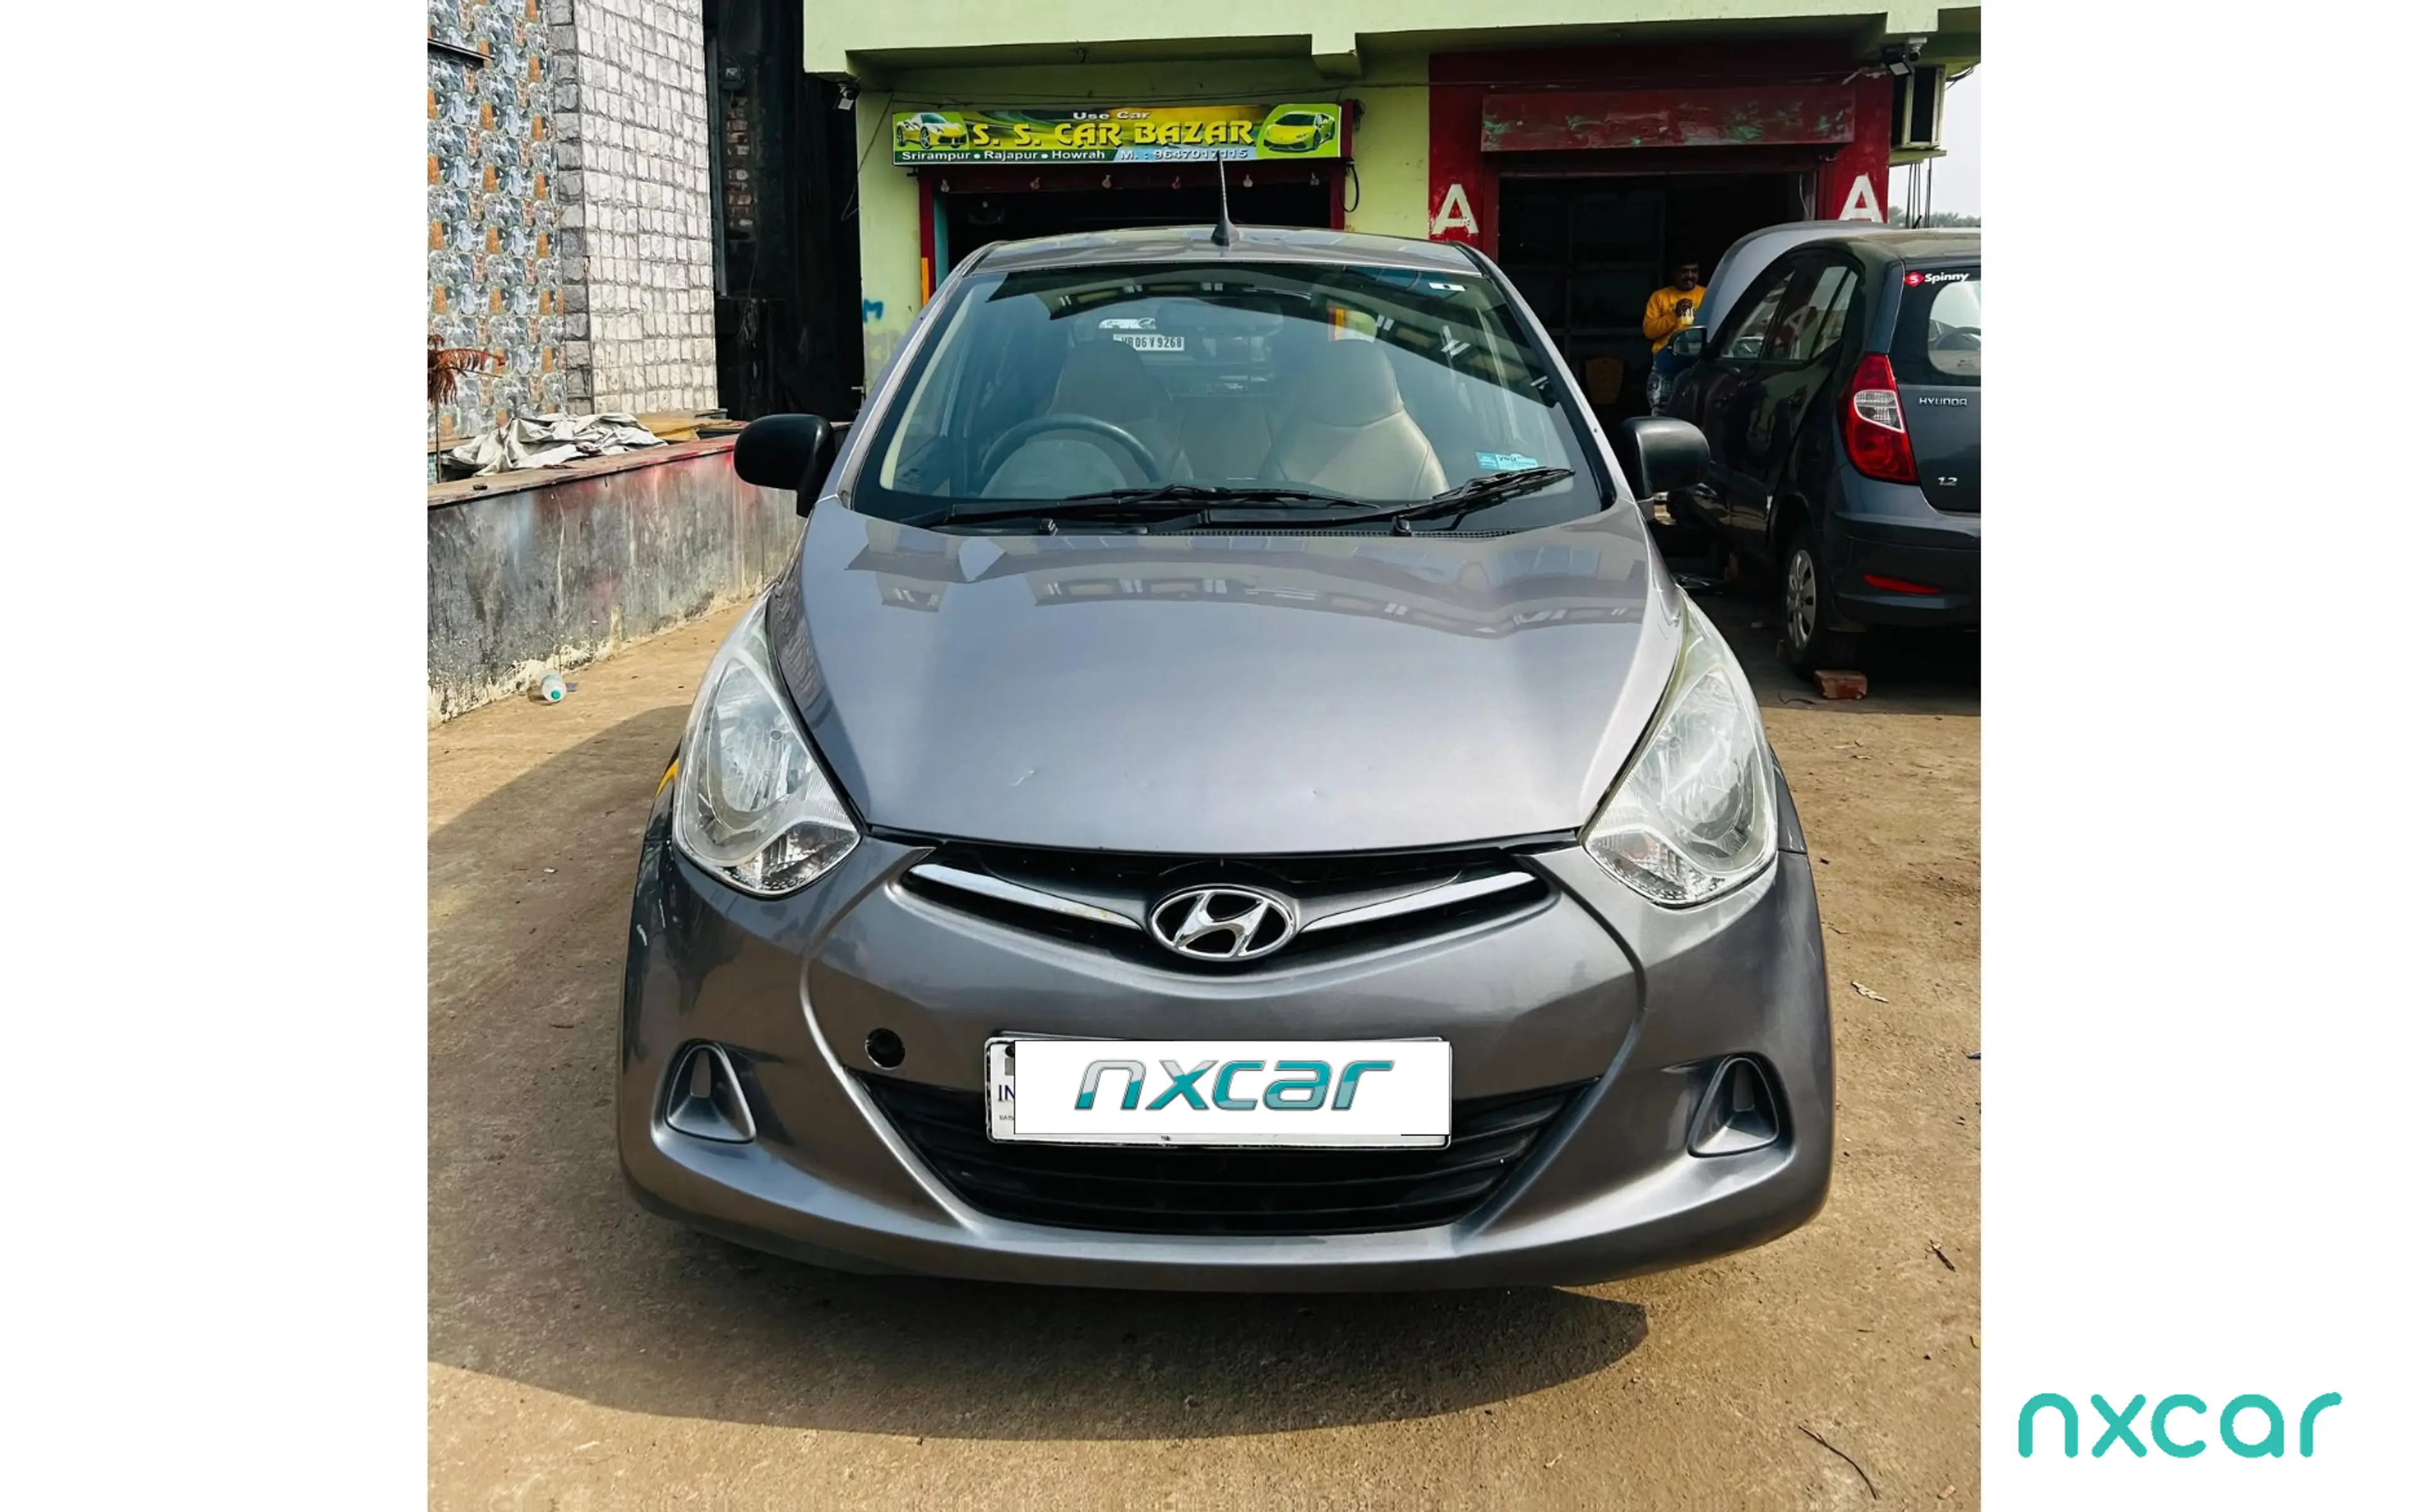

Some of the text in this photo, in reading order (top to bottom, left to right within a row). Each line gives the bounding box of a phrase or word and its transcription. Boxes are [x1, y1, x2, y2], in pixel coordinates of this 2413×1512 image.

[1116, 111, 1150, 119] Car
[973, 121, 1256, 148] S. S. CAR BAZAR
[902, 150, 1105, 162] Srirampur Rajapur Howrah
[1838, 175, 1884, 222] A
[1431, 184, 1479, 234] A
[1924, 271, 1970, 284] Spinny
[1157, 337, 1181, 348] 9268
